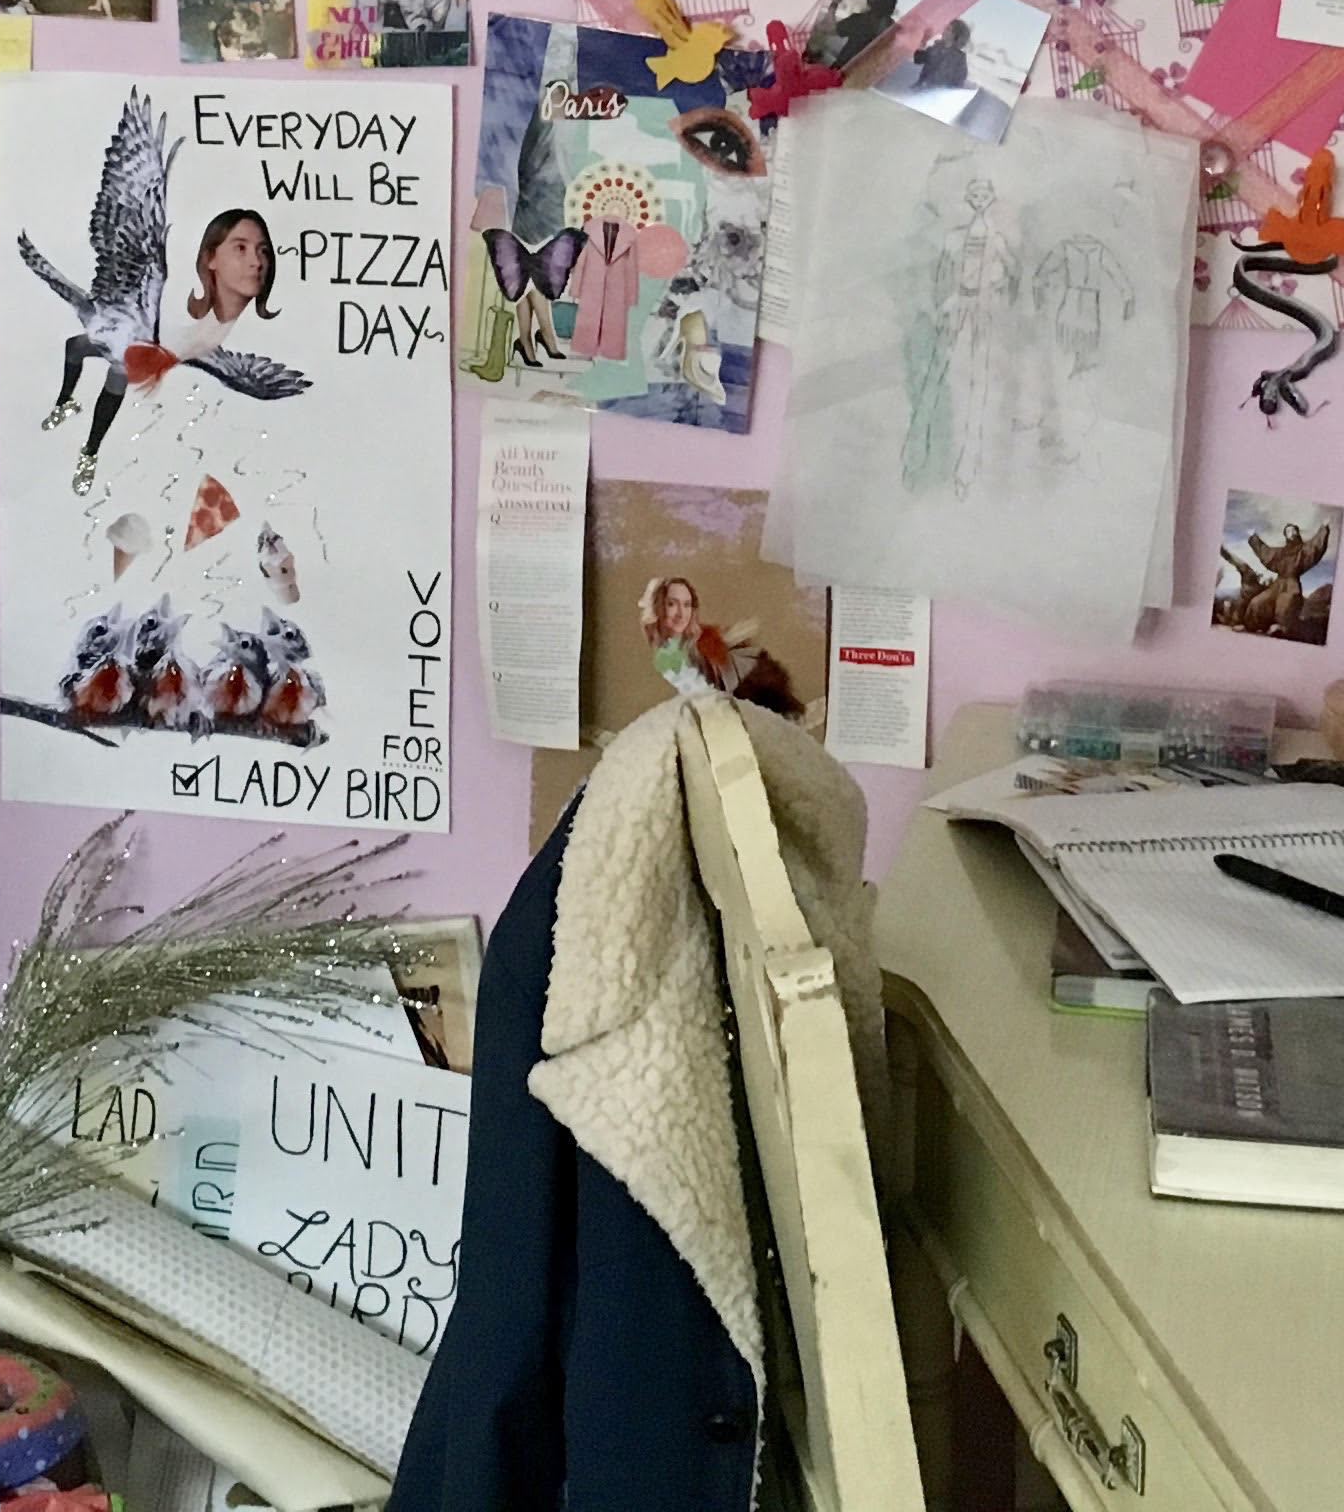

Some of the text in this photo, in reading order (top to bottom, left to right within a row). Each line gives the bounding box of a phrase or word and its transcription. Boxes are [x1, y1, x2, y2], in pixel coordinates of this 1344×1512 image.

[193, 94, 417, 155] EVERYDAY
[540, 80, 629, 122] Paris
[261, 159, 420, 206] WILL BE
[407, 569, 442, 729] VOTE
[842, 648, 875, 663] Three
[383, 734, 444, 766] FOR
[214, 754, 442, 823] LADY BIRD
[271, 1074, 468, 1186] UNIT
[257, 1209, 462, 1302] LADY
